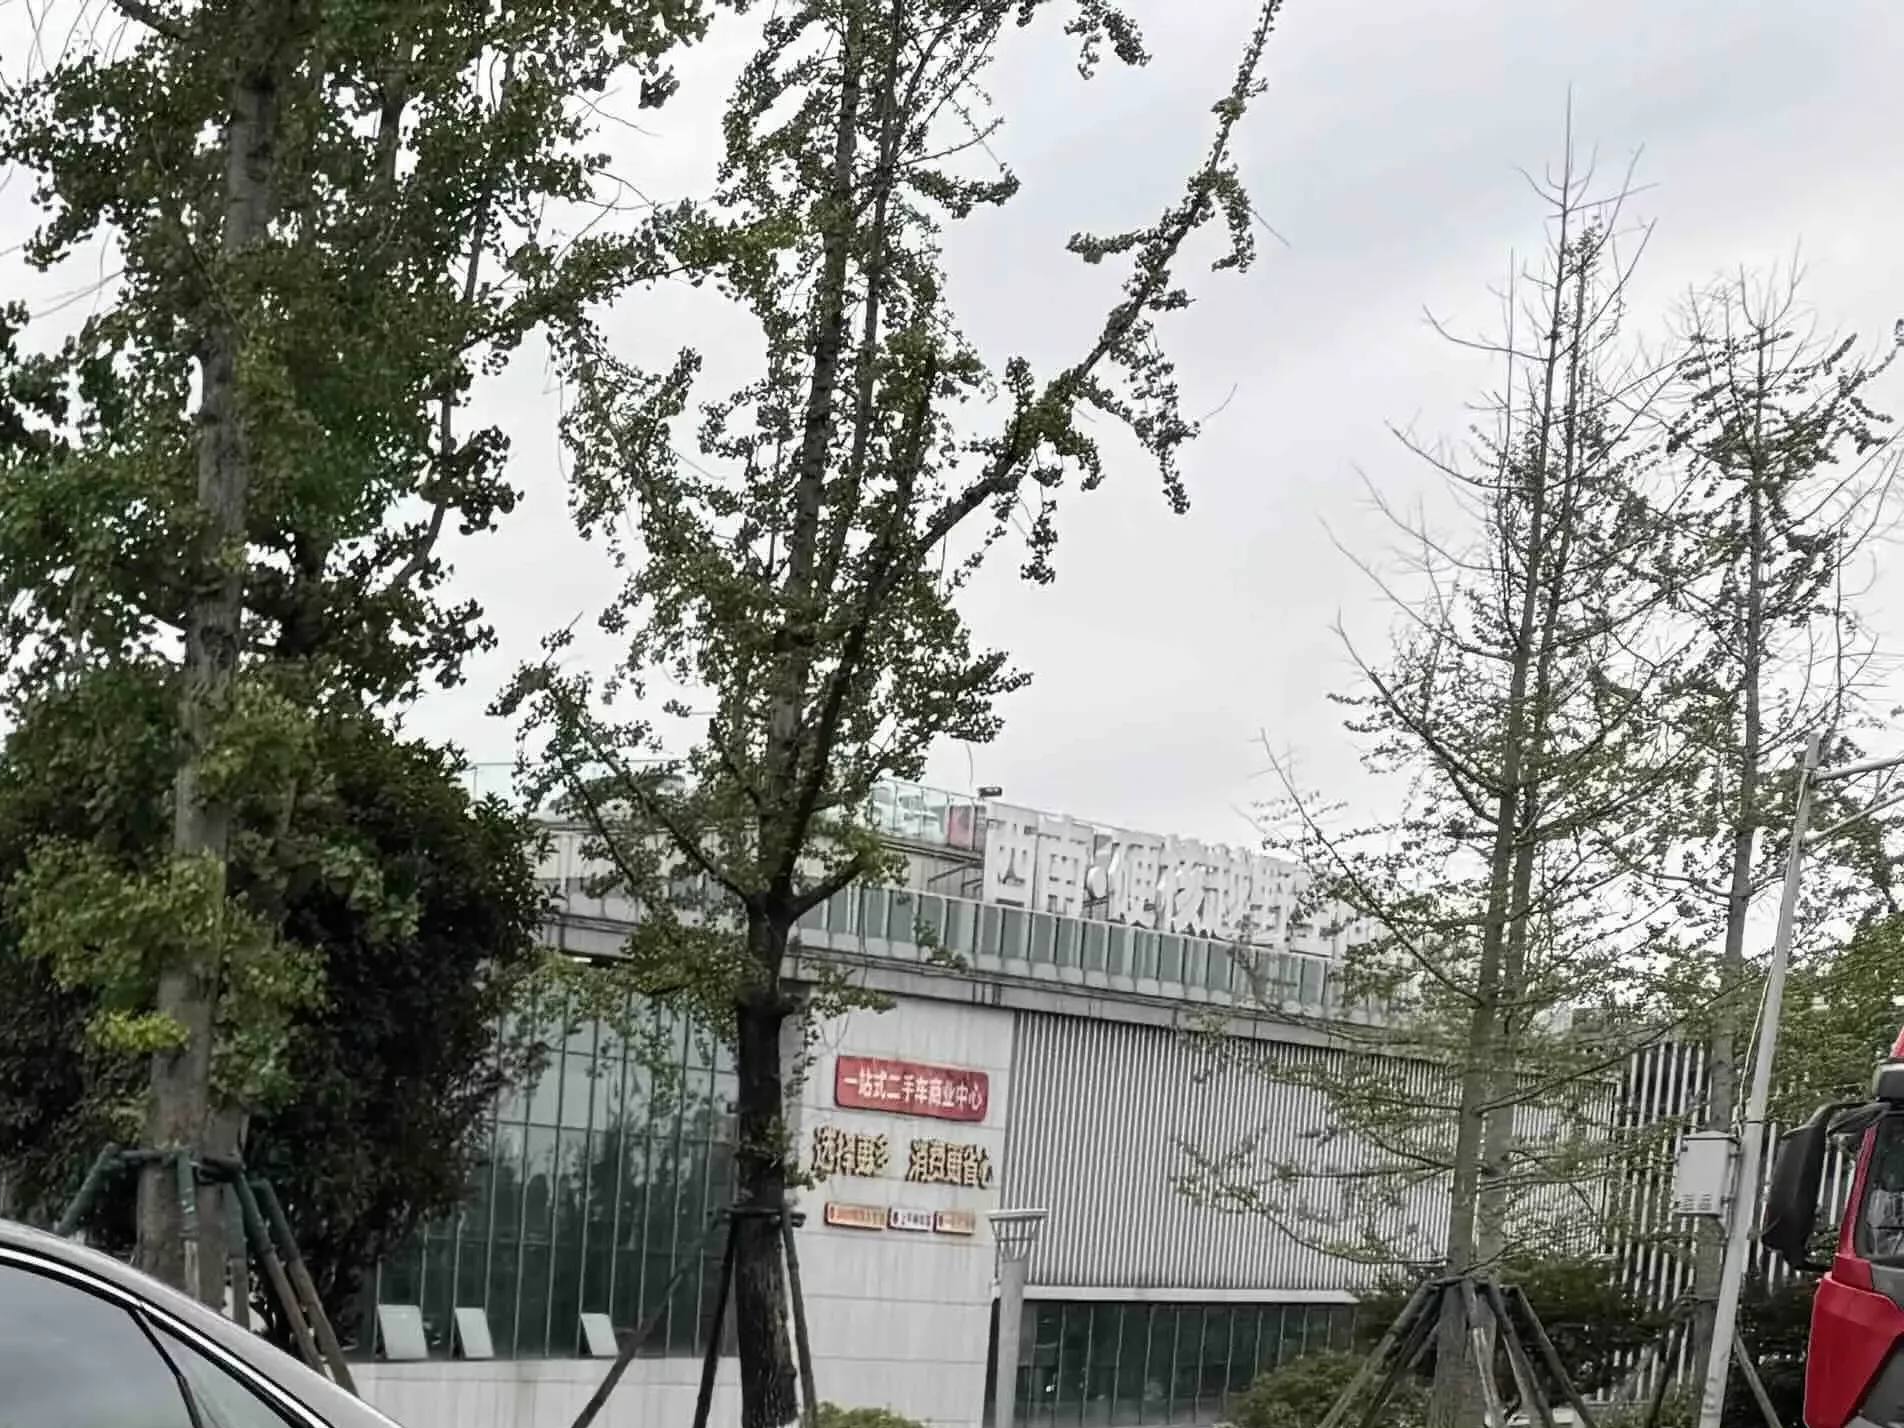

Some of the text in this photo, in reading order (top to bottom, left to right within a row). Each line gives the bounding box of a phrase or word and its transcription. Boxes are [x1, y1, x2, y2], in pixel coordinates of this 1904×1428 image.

[843, 1065, 983, 1111] 一站式二手车商业中心
